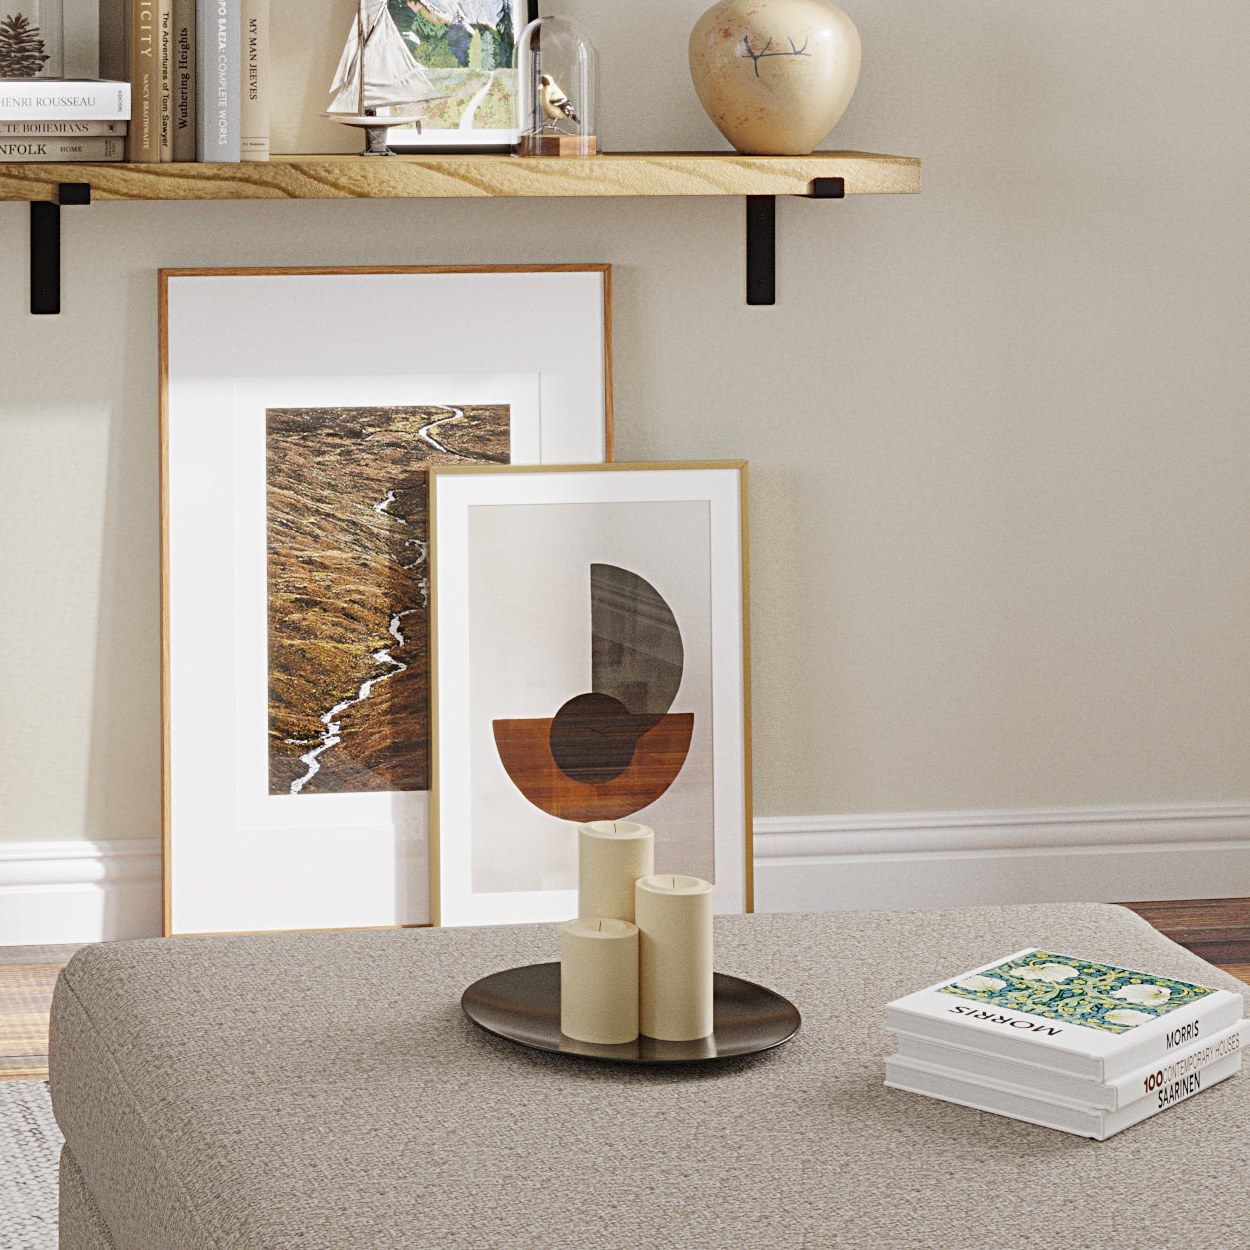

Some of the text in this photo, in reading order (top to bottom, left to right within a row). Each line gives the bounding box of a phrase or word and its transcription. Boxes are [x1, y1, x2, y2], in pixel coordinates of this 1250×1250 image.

[218, 18, 227, 52] BAEZA:
[249, 18, 257, 101] MY MAN JEEVES
[162, 82, 169, 93] of
[178, 27, 190, 129] Wuthering Heights
[218, 55, 227, 107] COMPLETE
[36, 97, 96, 107] ROUSSEAU
[23, 123, 89, 133] BOHEMIANS
[160, 114, 169, 147] Sawyer
[218, 108, 227, 146] WORKS
[948, 1005, 1063, 1037] MORRIS
[1166, 1020, 1199, 1050] MORRIS
[1213, 1033, 1240, 1060] HOUSES
[1157, 1072, 1201, 1109] SAARINEN
